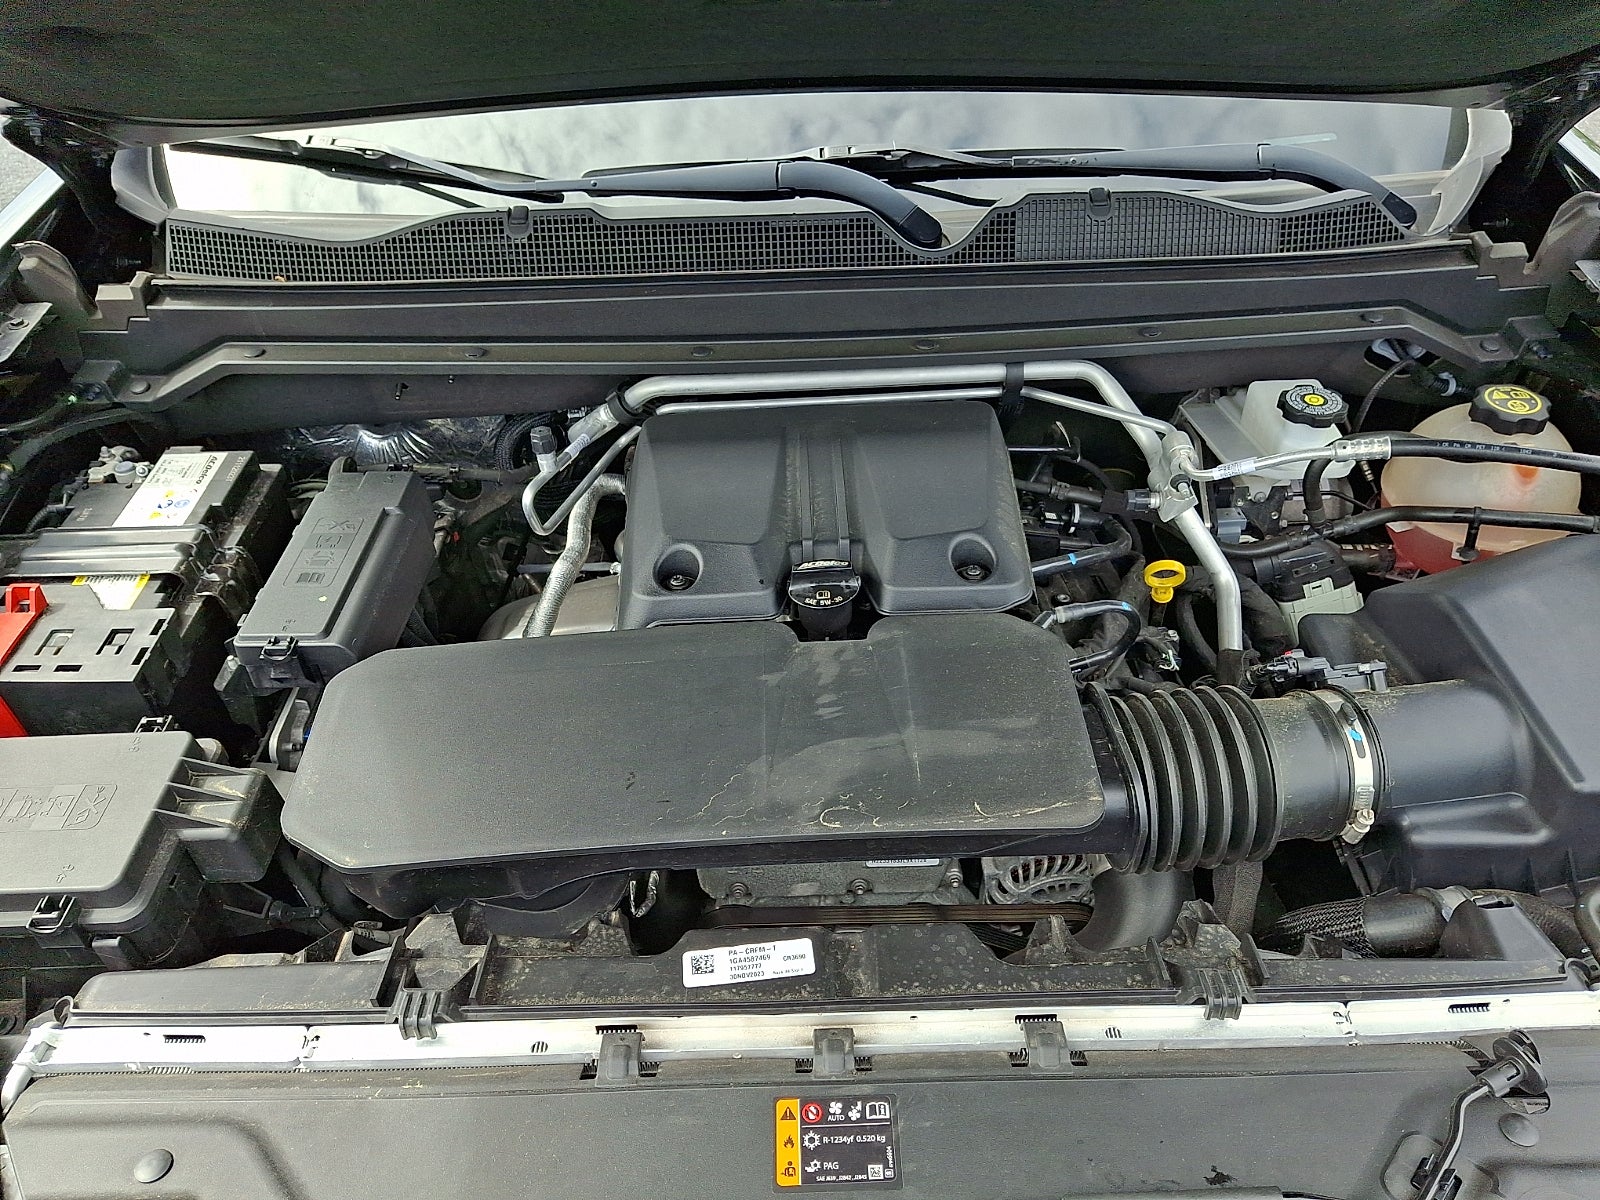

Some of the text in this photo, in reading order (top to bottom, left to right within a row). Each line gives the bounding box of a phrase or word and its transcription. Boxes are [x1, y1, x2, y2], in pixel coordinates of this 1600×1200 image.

[195, 455, 218, 485] ACDelco
[797, 561, 849, 570] ACDelco
[804, 595, 843, 605] SAE 5W-30
[729, 970, 765, 980] 30NOV2023
[827, 1114, 846, 1122] AUTO
[823, 1134, 886, 1145] R-1234yf 0.520 kg
[823, 1161, 839, 1171] PAG
